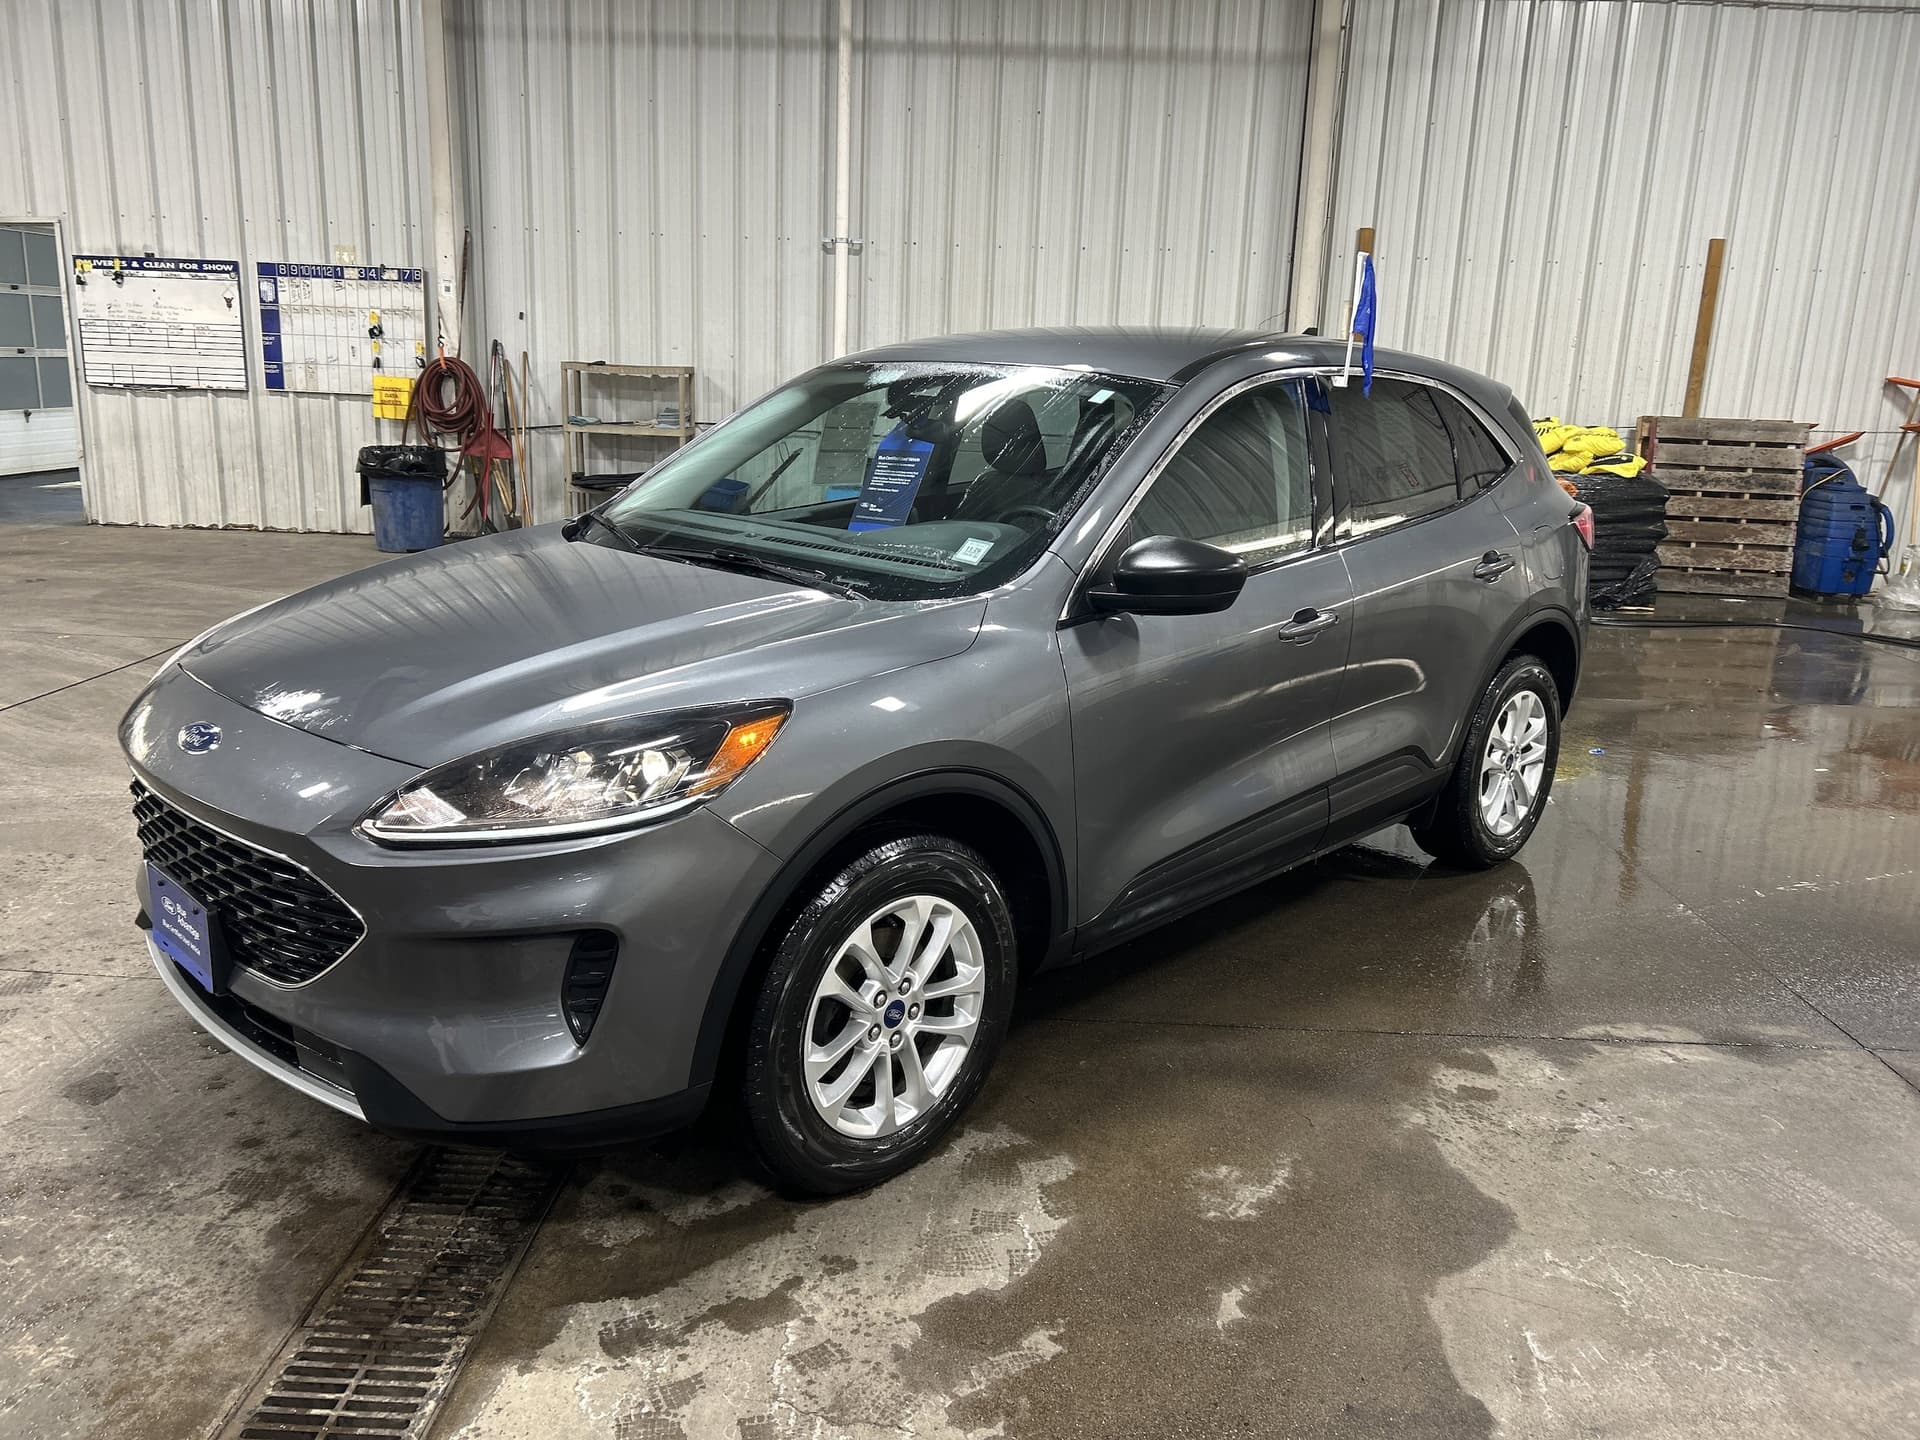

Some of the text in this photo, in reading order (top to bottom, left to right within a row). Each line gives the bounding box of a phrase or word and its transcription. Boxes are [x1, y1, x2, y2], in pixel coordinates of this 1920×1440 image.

[202, 263, 234, 271] SHOW
[279, 265, 421, 280] 8 9 10 11 12 1 3 4 7 8
[176, 902, 187, 918] Blue
[178, 914, 200, 940] Advantage
